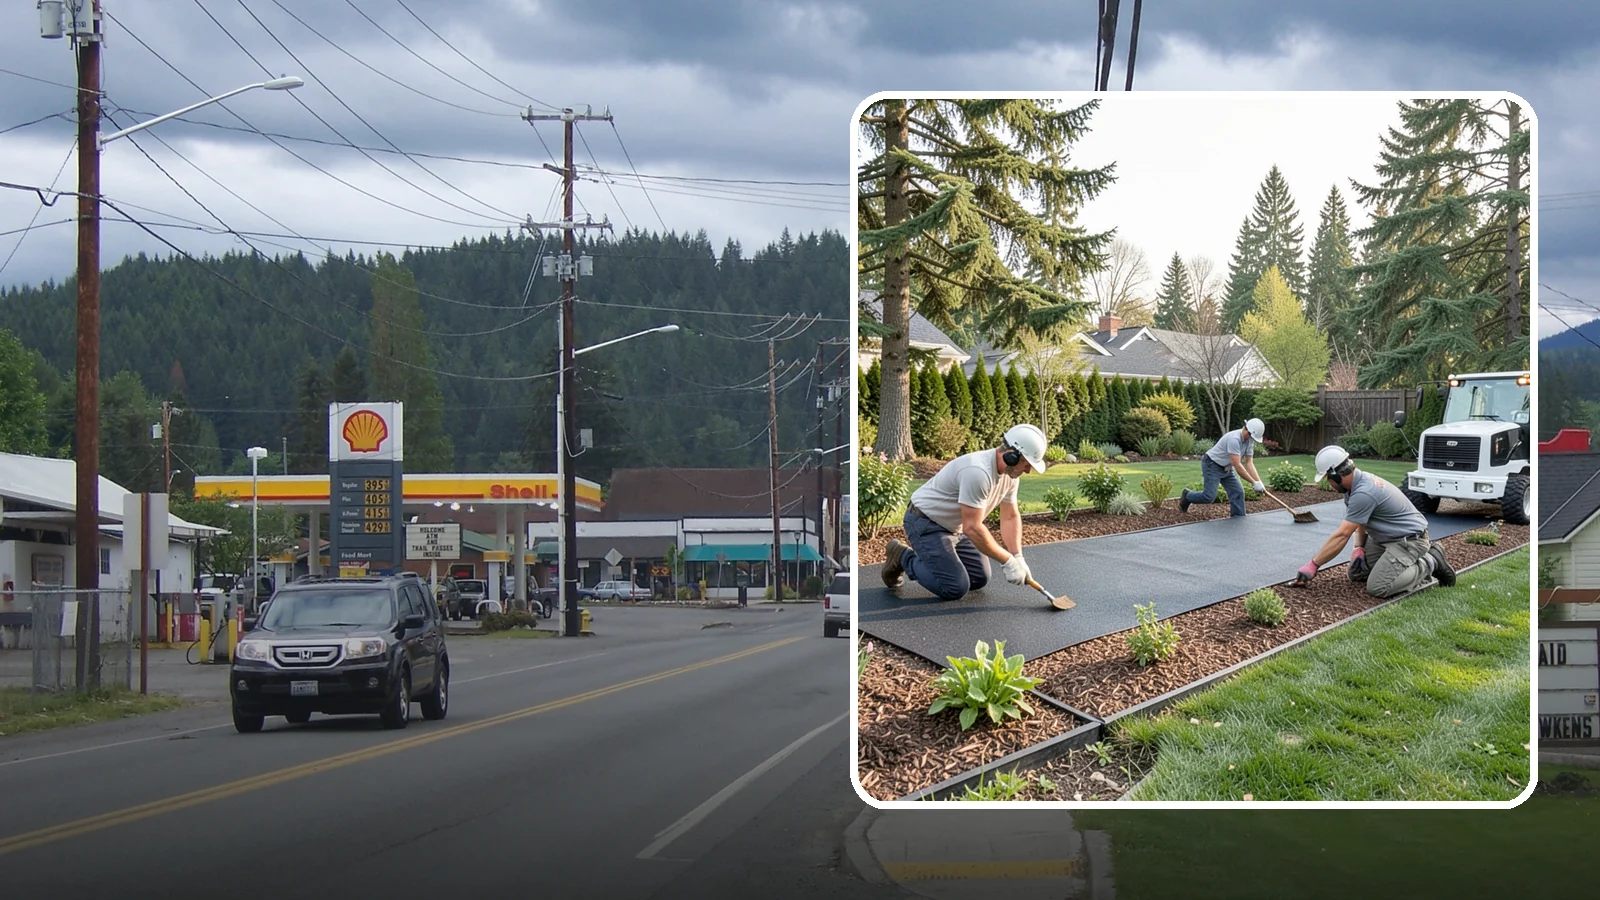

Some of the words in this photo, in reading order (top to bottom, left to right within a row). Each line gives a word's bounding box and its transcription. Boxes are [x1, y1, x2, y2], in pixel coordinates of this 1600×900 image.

[490, 484, 547, 499] Shell
[1539, 642, 1567, 666] AID
[1538, 715, 1592, 739] WKENS
